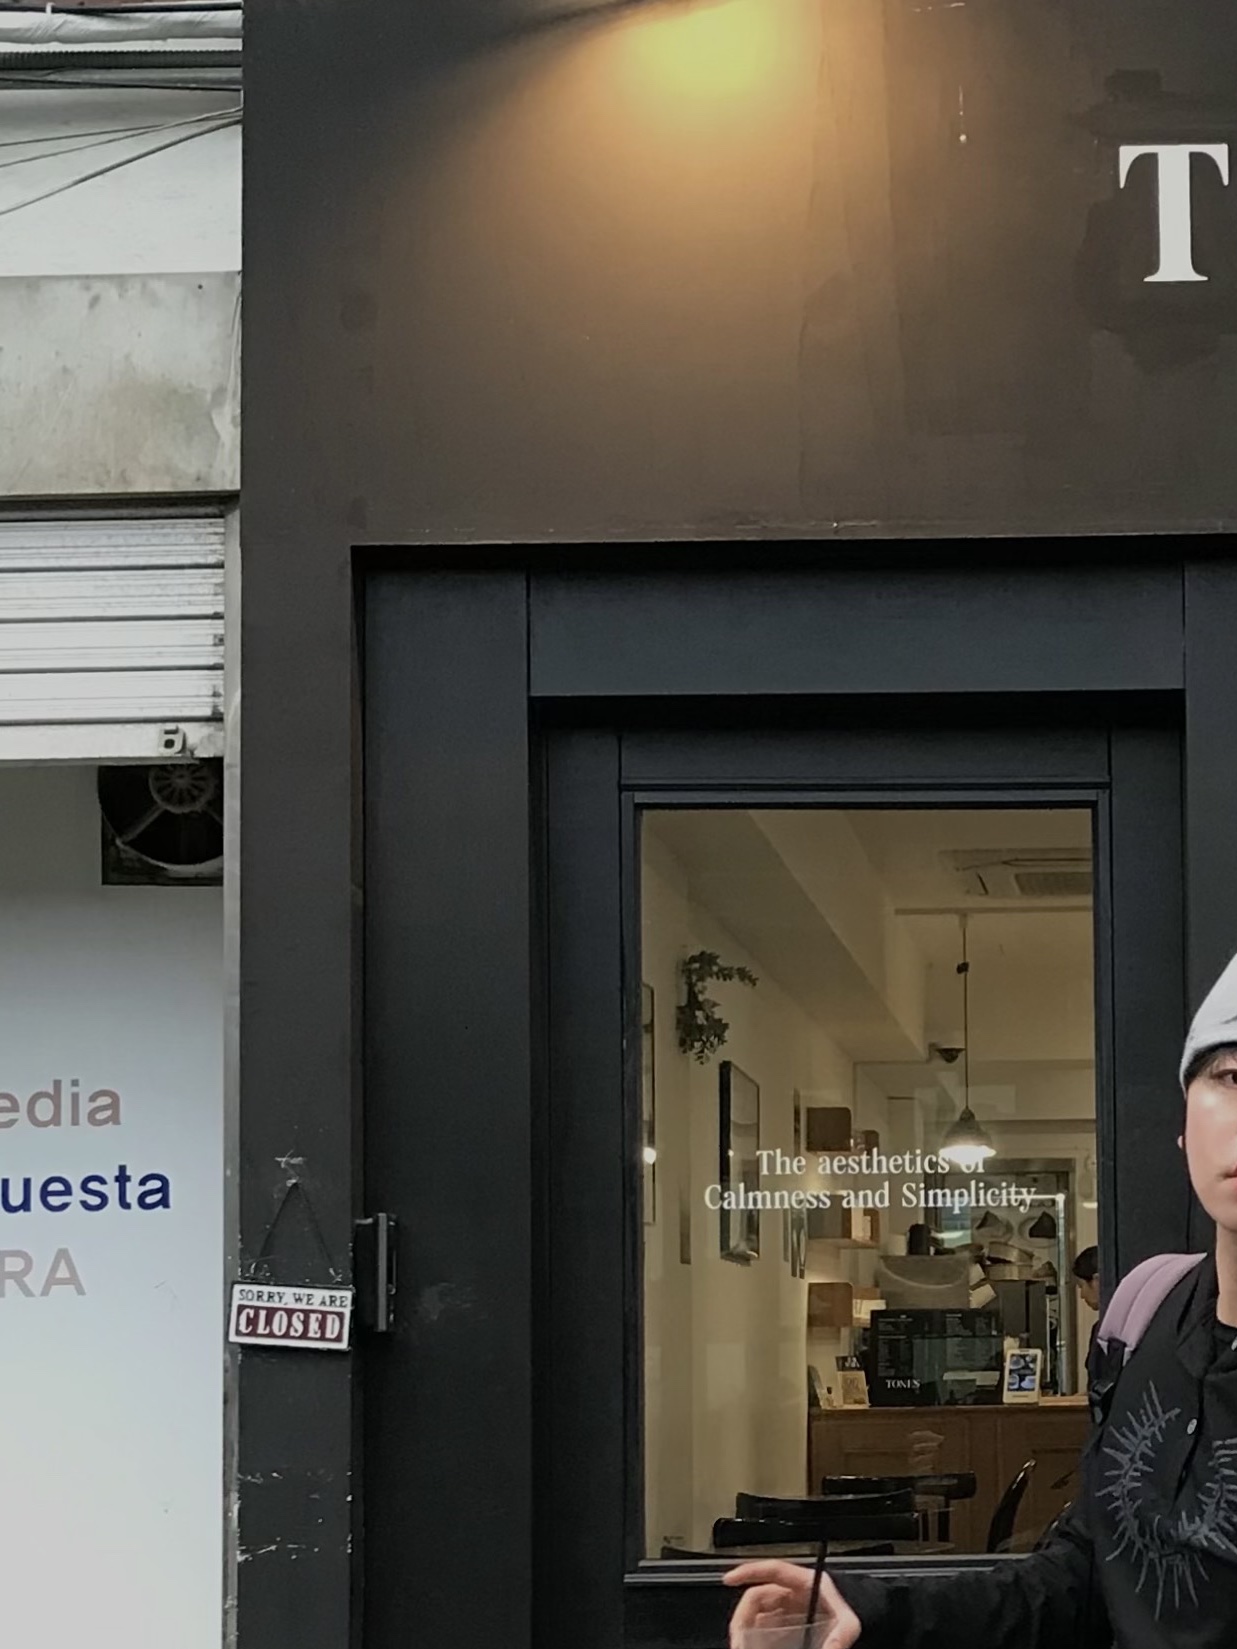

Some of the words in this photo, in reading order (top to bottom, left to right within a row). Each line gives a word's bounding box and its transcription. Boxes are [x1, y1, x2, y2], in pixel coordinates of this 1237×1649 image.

[0, 1079, 121, 1129] edia
[756, 1148, 806, 1175] The
[818, 1148, 950, 1174] aesthetics
[1, 1164, 171, 1213] uesta
[704, 1182, 832, 1210] Calmness
[842, 1181, 890, 1208] and
[902, 1180, 1038, 1214] Simplicity
[0, 1247, 86, 1298] RA
[239, 1289, 288, 1306] SORRY,
[292, 1292, 314, 1305] WE
[319, 1294, 348, 1308] ARE
[239, 1308, 340, 1339] CLOSED
